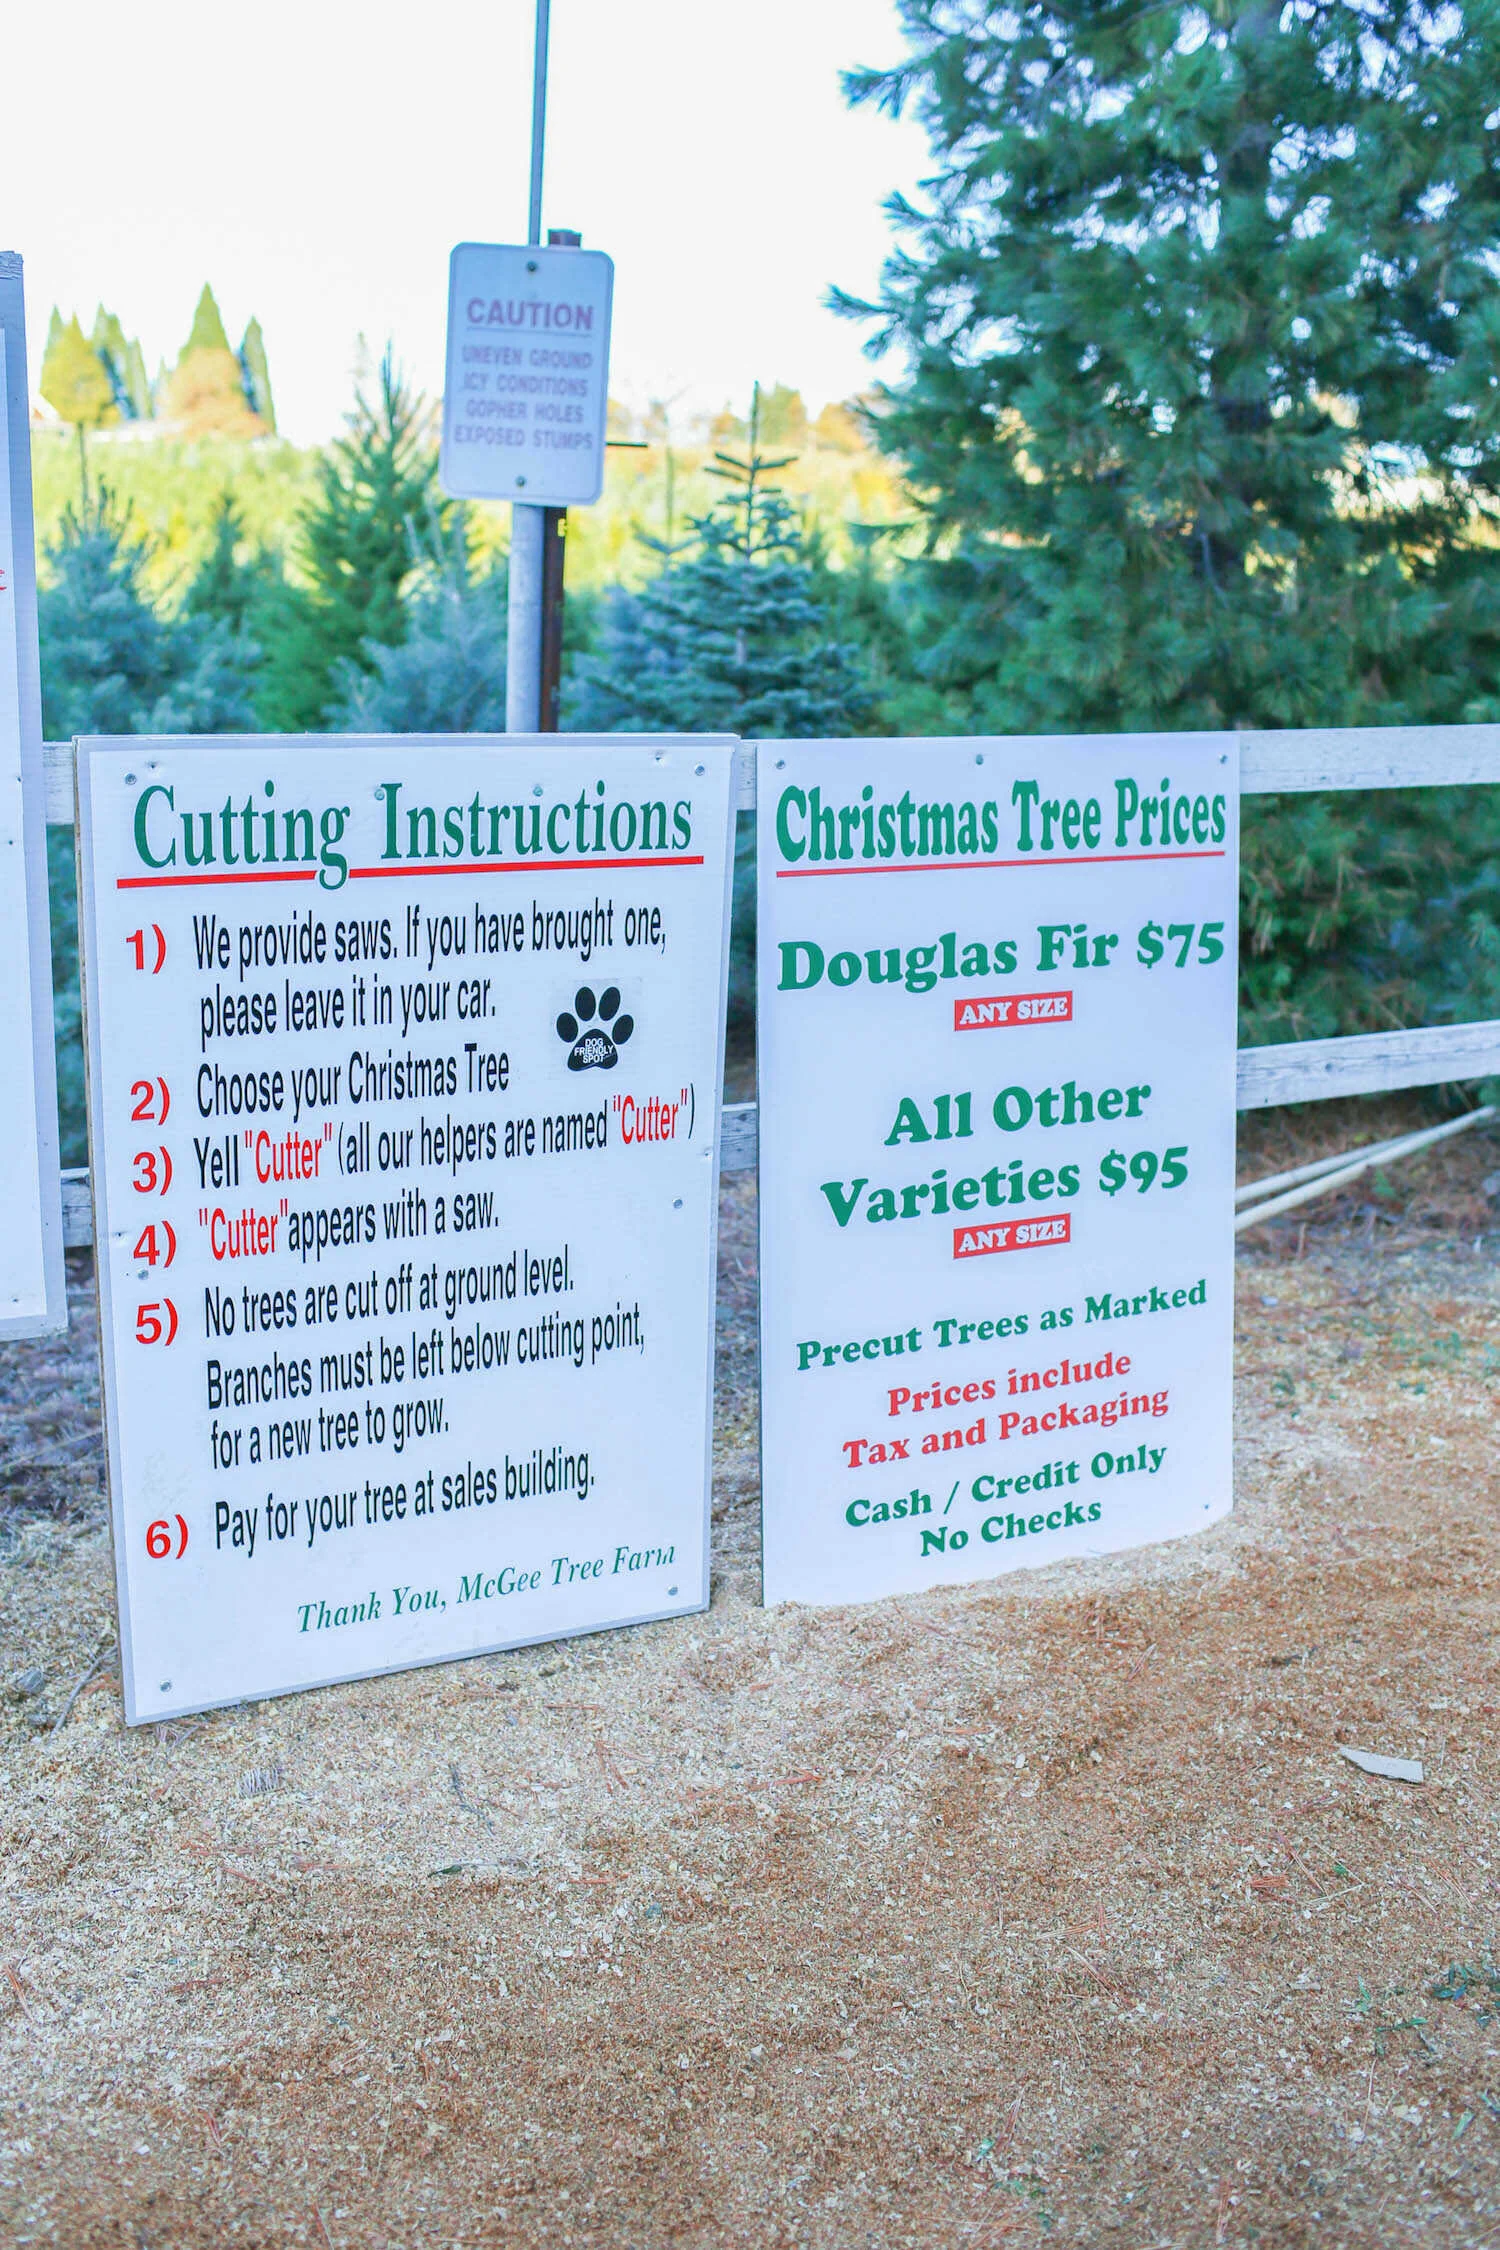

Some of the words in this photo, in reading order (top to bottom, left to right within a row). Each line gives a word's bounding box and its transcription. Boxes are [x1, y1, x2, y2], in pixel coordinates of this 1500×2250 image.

[467, 298, 593, 330] CAUTION
[462, 345, 522, 366] UNEVEN
[530, 350, 592, 369] GROUND
[464, 373, 489, 391] ICY
[497, 375, 588, 398] CONDITIONS
[454, 425, 524, 446] EXPOSED
[533, 430, 592, 449] STUMPS
[466, 400, 527, 420] GOPHER
[535, 404, 584, 423] HOLES
[132, 779, 350, 889] Cutting
[380, 780, 691, 859] Instructions
[776, 785, 998, 862] Christmas
[1012, 779, 1101, 852] Tree
[1114, 777, 1226, 847] Prices
[126, 924, 166, 974] 1)
[193, 914, 230, 969] We
[240, 910, 326, 982] provide
[335, 919, 397, 962] saws.
[407, 904, 419, 957] If
[427, 916, 465, 971] you
[475, 903, 524, 953] have
[532, 897, 613, 962] brought
[625, 907, 665, 954] one,
[777, 932, 1017, 993] Douglas
[1036, 924, 1119, 971] Fir
[1137, 920, 1224, 969] $75
[201, 984, 276, 1053] please
[286, 979, 344, 1032] leave
[353, 974, 365, 1026] it
[374, 973, 392, 1024] in
[400, 982, 450, 1038] your
[458, 979, 495, 1019] car.
[585, 1038, 603, 1046] DOG
[959, 1003, 1010, 1026] ANY
[1017, 997, 1068, 1020] SIZE
[131, 1077, 170, 1125] 2)
[198, 1063, 283, 1117] Choose
[291, 1066, 341, 1123] your
[349, 1049, 456, 1104] Christmas
[464, 1043, 509, 1093] Tree
[574, 1045, 614, 1056] FRIENDLY
[583, 1054, 605, 1063] SPOT
[133, 1146, 172, 1195] 3)
[193, 1135, 239, 1189] Yell
[245, 1123, 332, 1183] "Cutter"
[339, 1121, 369, 1175] (all
[378, 1130, 413, 1171] our
[421, 1114, 496, 1176] helpers
[505, 1118, 535, 1158] are
[543, 1099, 607, 1153] named
[884, 1092, 974, 1146] All
[993, 1081, 1151, 1132] Other
[820, 1160, 1080, 1227] Varieties
[1099, 1146, 1188, 1197] $95
[134, 1221, 176, 1268] 4)
[383, 1187, 426, 1239] with
[435, 1197, 446, 1234] a
[453, 1192, 498, 1232] saw.
[957, 1230, 1010, 1252] ANY
[1015, 1220, 1067, 1245] SIZE
[136, 1299, 178, 1346] 5)
[205, 1286, 235, 1338] No
[242, 1286, 297, 1332] trees
[305, 1285, 337, 1325] are
[346, 1271, 378, 1320] cut
[386, 1263, 412, 1315] off
[420, 1263, 437, 1310] at
[445, 1251, 516, 1320] ground
[525, 1244, 573, 1296] level.
[797, 1328, 922, 1370] Precut
[933, 1315, 1028, 1347] Trees
[1040, 1308, 1073, 1330] as
[1085, 1279, 1206, 1323] Marked
[207, 1352, 312, 1410] Branches
[320, 1341, 373, 1393] must
[380, 1336, 404, 1384] be
[413, 1328, 443, 1379] left
[451, 1323, 510, 1373] below
[517, 1311, 584, 1368] cutting
[592, 1302, 644, 1365] point,
[888, 1380, 995, 1416] Prices
[1008, 1352, 1130, 1397] include
[211, 1420, 241, 1469] for
[250, 1427, 261, 1464] a
[269, 1419, 311, 1460] new
[318, 1408, 358, 1452] tree
[366, 1400, 385, 1444] to
[393, 1398, 448, 1453] grow.
[843, 1439, 909, 1467] Tax
[922, 1418, 986, 1454] and
[999, 1391, 1168, 1439] Packaging
[146, 1515, 188, 1559] 6)
[216, 1501, 258, 1558] Pay
[266, 1493, 297, 1540] for
[306, 1491, 357, 1548] your
[364, 1481, 406, 1524] tree
[415, 1470, 434, 1516] at
[442, 1461, 497, 1511] sales
[506, 1446, 594, 1500] building.
[846, 1489, 932, 1527] Cash
[944, 1481, 959, 1514] /
[972, 1461, 1080, 1502] Credit
[1091, 1444, 1167, 1478] Only
[920, 1527, 968, 1556] No
[981, 1501, 1101, 1543] Checks
[298, 1592, 380, 1632] Thank
[393, 1587, 446, 1615] You,
[457, 1568, 541, 1603] McGee
[552, 1558, 603, 1585] Tree
